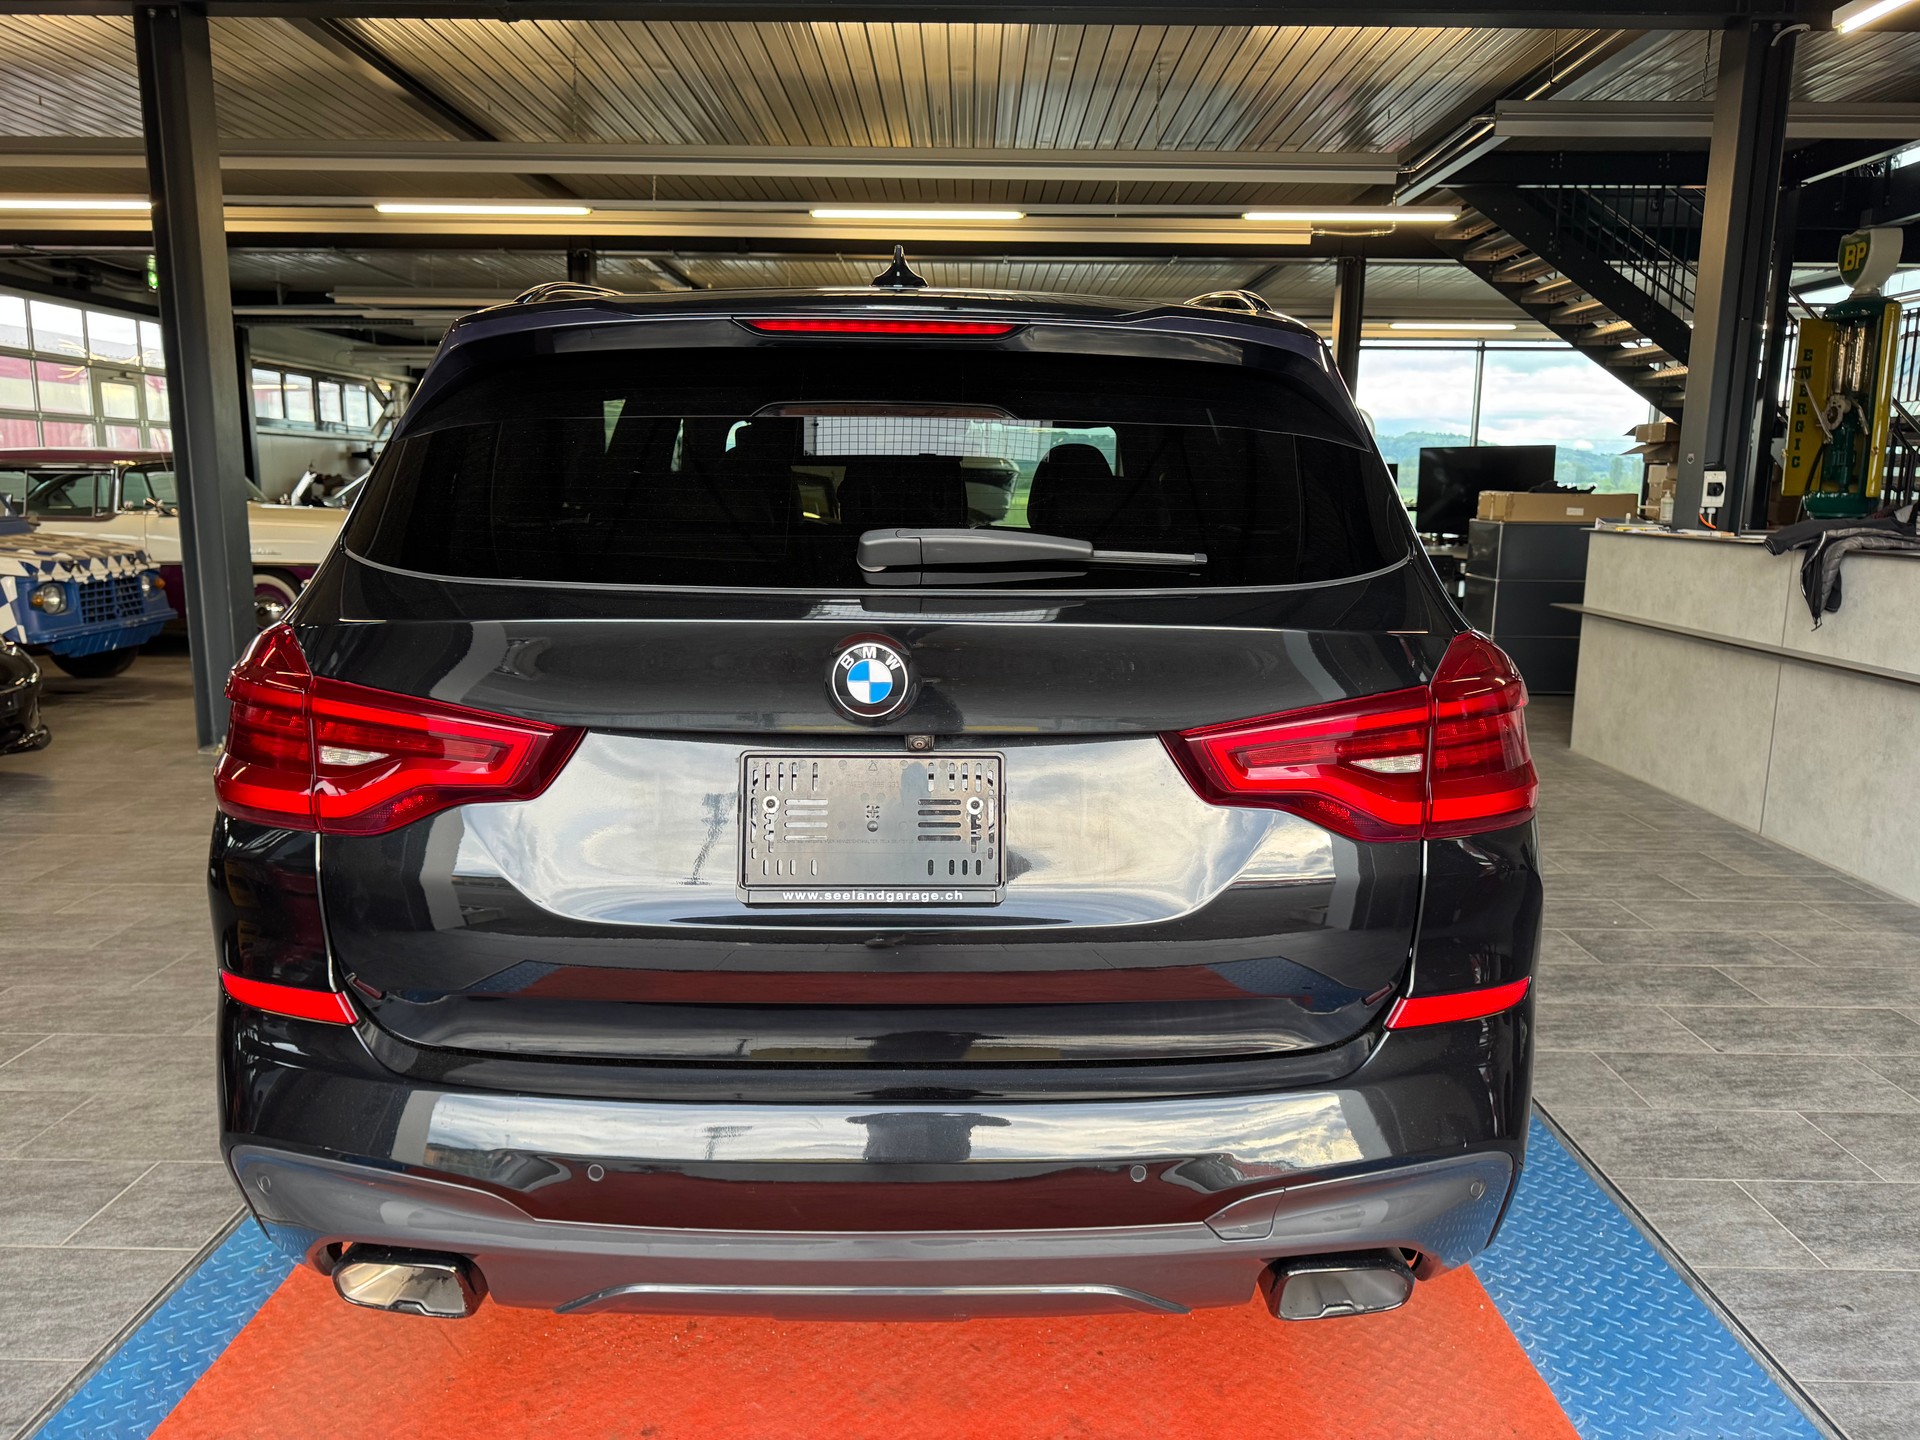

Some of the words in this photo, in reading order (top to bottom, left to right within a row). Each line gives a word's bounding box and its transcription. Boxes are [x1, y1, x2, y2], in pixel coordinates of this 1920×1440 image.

[1843, 241, 1868, 272] BP
[1791, 348, 1814, 468] ENERGIC
[840, 646, 901, 671] BMW
[782, 890, 964, 903] www.seelandgarage.ch
